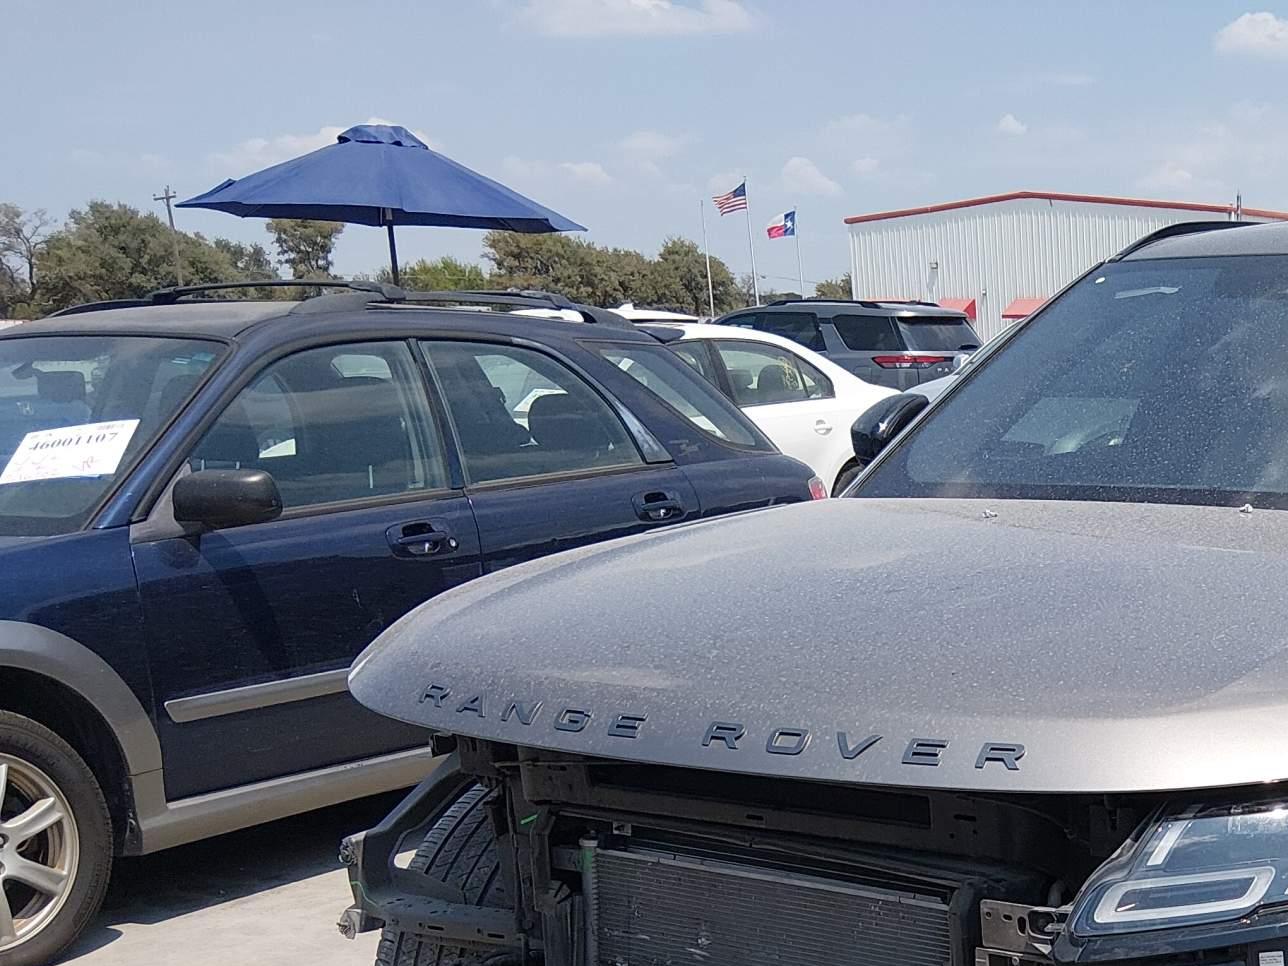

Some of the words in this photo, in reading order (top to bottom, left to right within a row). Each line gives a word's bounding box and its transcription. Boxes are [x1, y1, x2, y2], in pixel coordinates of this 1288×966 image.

[28, 431, 119, 451] 46001107
[418, 682, 650, 739] RANGE
[701, 720, 1027, 771] ROVER
